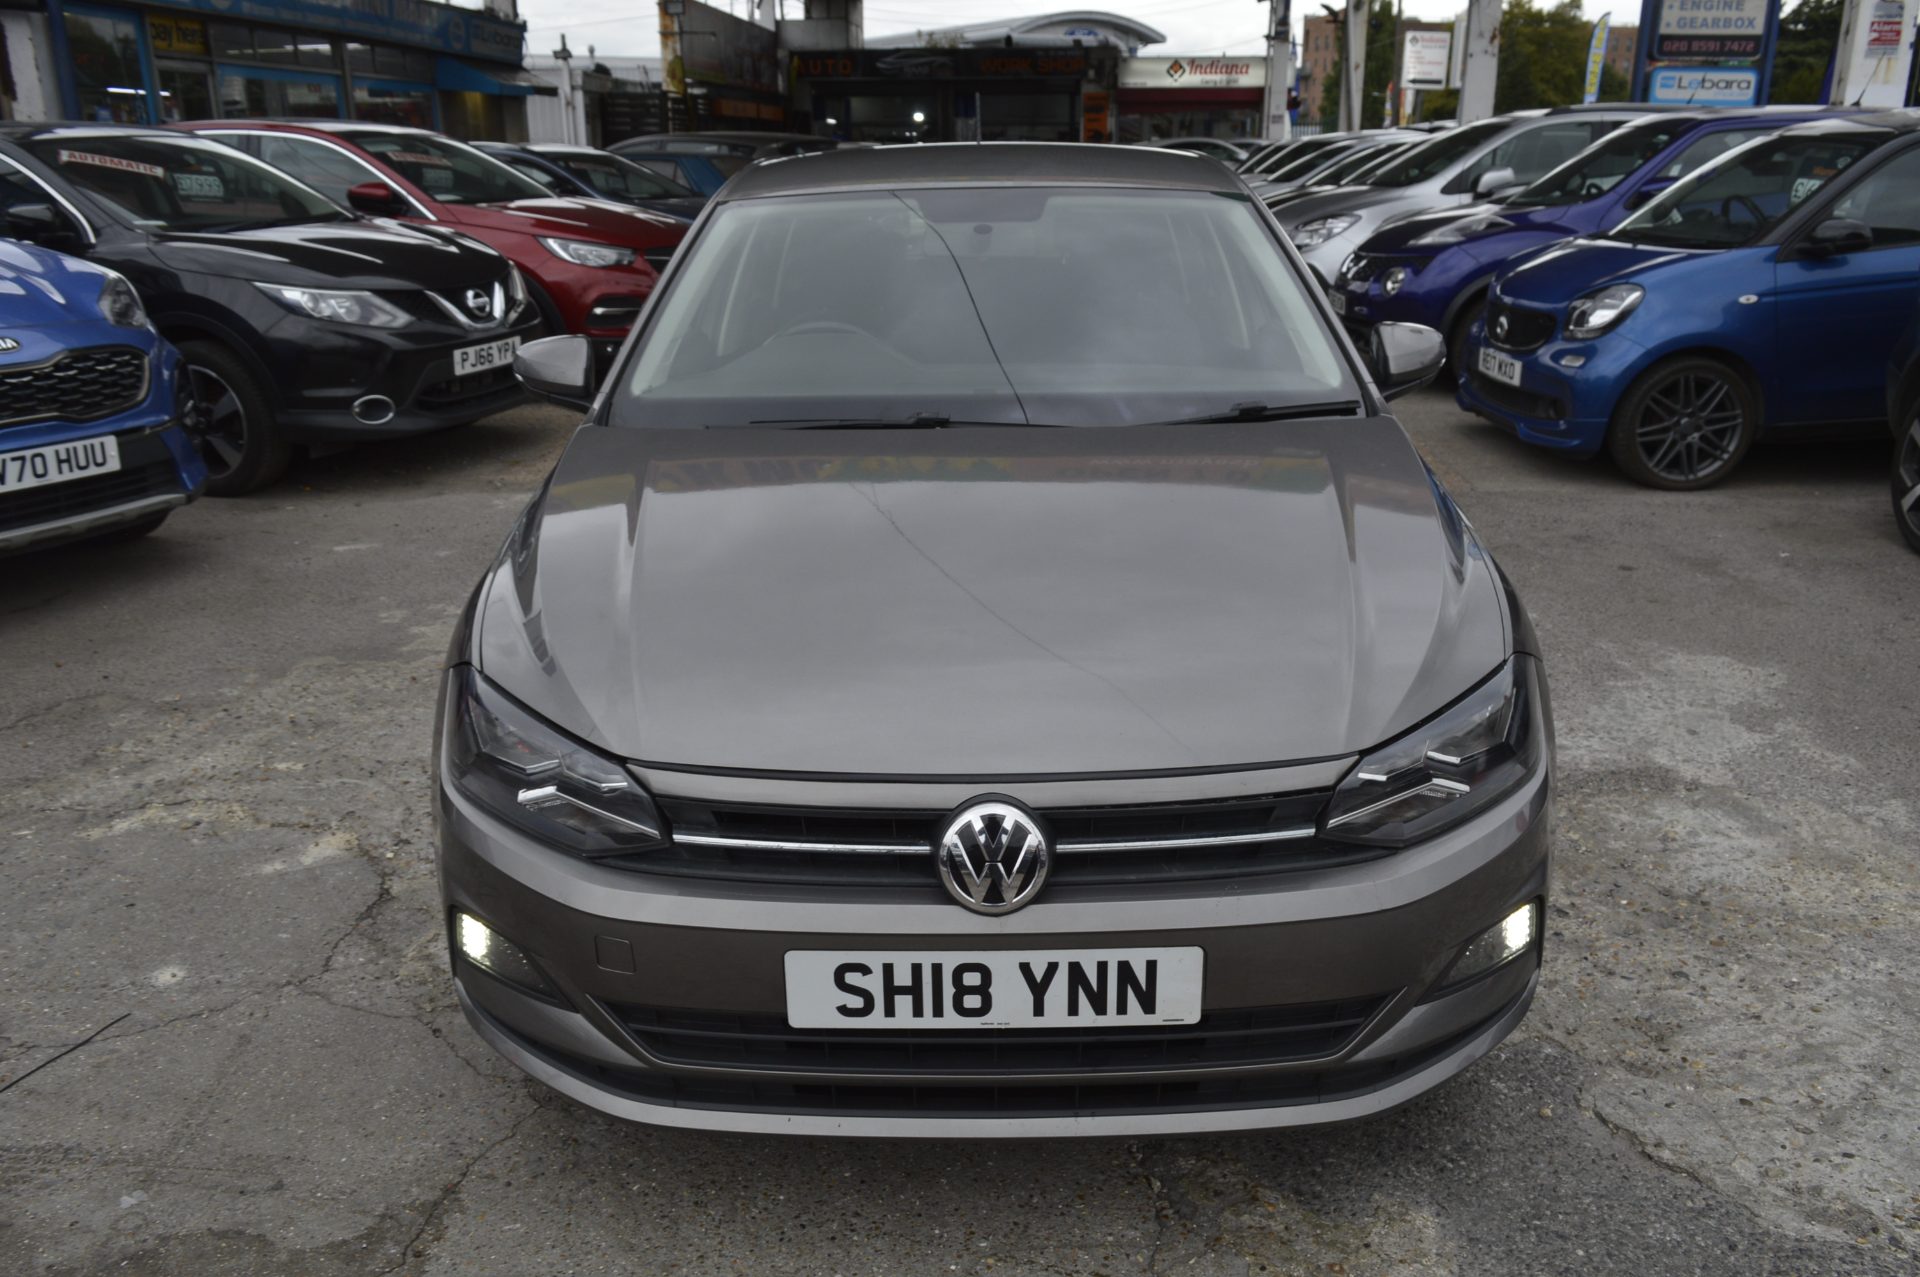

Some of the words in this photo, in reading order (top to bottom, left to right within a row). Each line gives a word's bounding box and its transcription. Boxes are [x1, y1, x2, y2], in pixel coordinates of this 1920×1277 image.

[1679, 0, 1744, 12] ENGINE
[1676, 17, 1756, 29] GEARBOX
[1663, 40, 1688, 52] 020
[1691, 40, 1720, 52] 8591
[1723, 40, 1756, 52] 7472
[797, 57, 854, 76] AUTO
[980, 56, 1032, 74] WORK
[1037, 56, 1086, 75] SHOP
[1187, 59, 1251, 76] Indiana
[1677, 75, 1751, 90] Lebara
[68, 151, 158, 175] AUTOMATIC
[461, 346, 494, 370] PJ66
[55, 441, 107, 475] HUU
[833, 962, 993, 1018] SH18
[1018, 959, 1158, 1017] YNN
